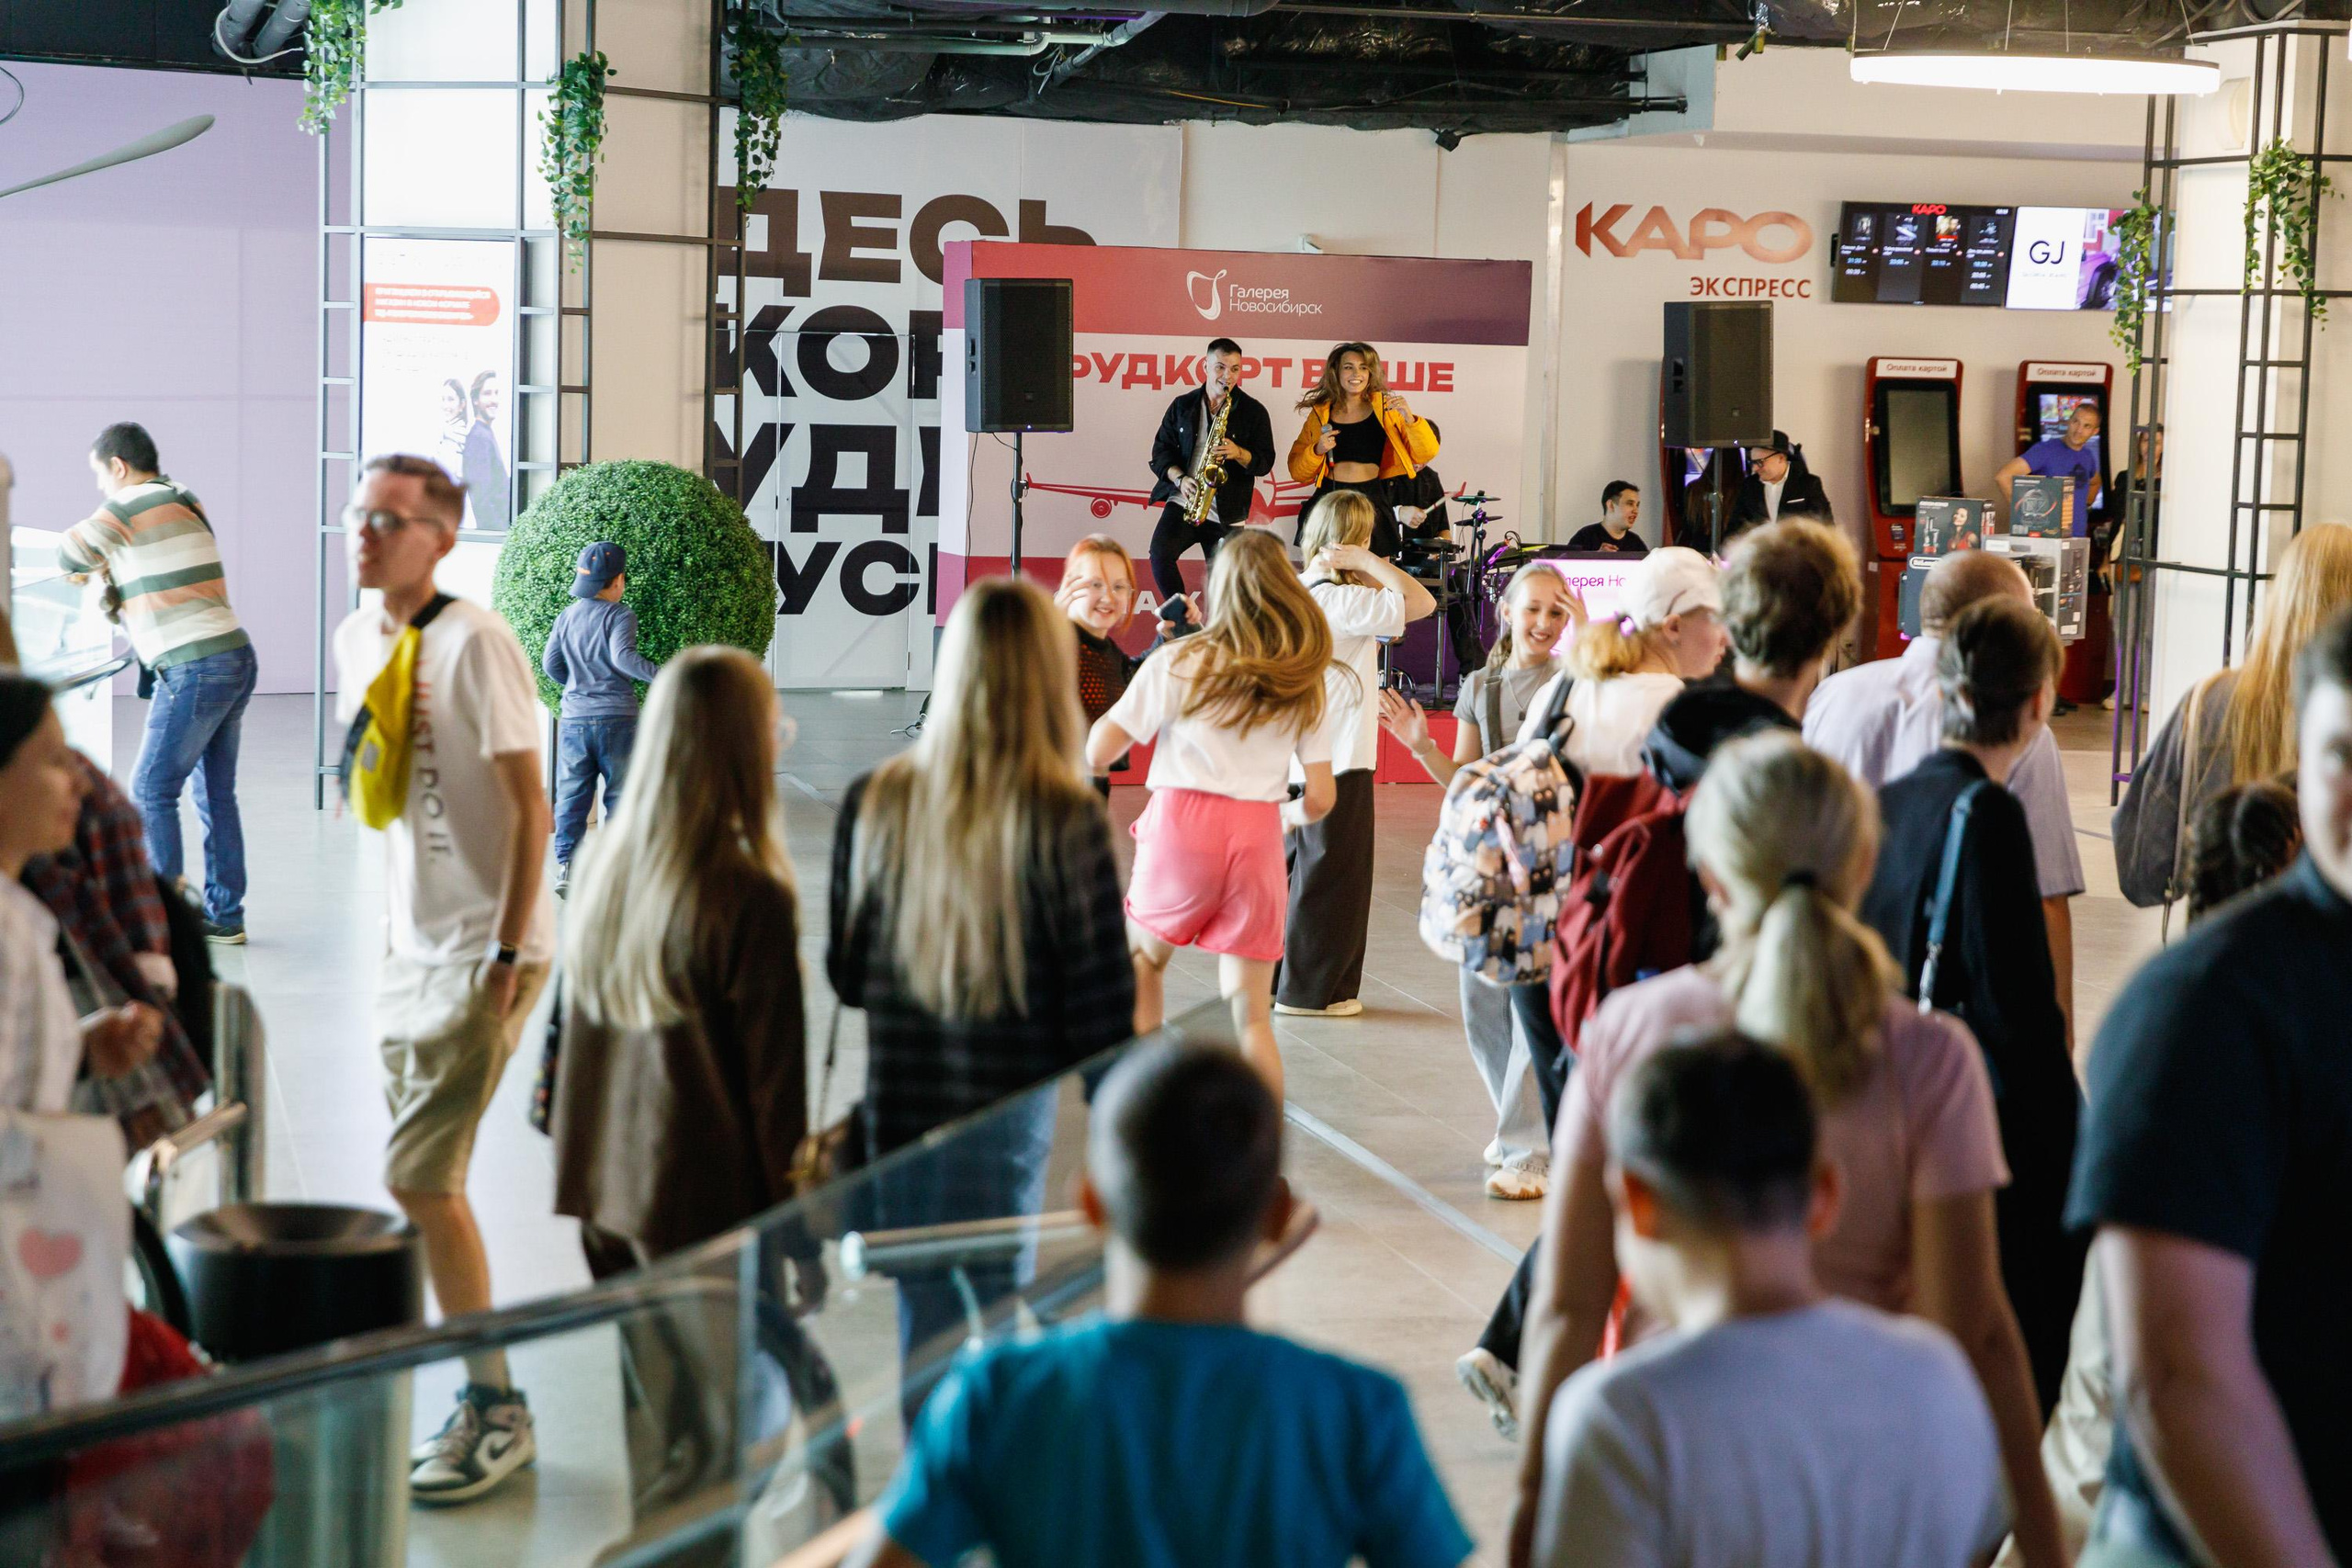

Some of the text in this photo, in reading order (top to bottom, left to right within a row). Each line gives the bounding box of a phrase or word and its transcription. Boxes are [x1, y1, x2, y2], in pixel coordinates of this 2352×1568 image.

[1575, 200, 1815, 265] КАРО
[2029, 240, 2065, 265] GJ
[1228, 284, 1290, 302] Галерея
[1689, 276, 1812, 299] ЭКСПРЕСС
[1228, 299, 1323, 317] Новосибирск
[1301, 357, 1454, 392] ВШЕ
